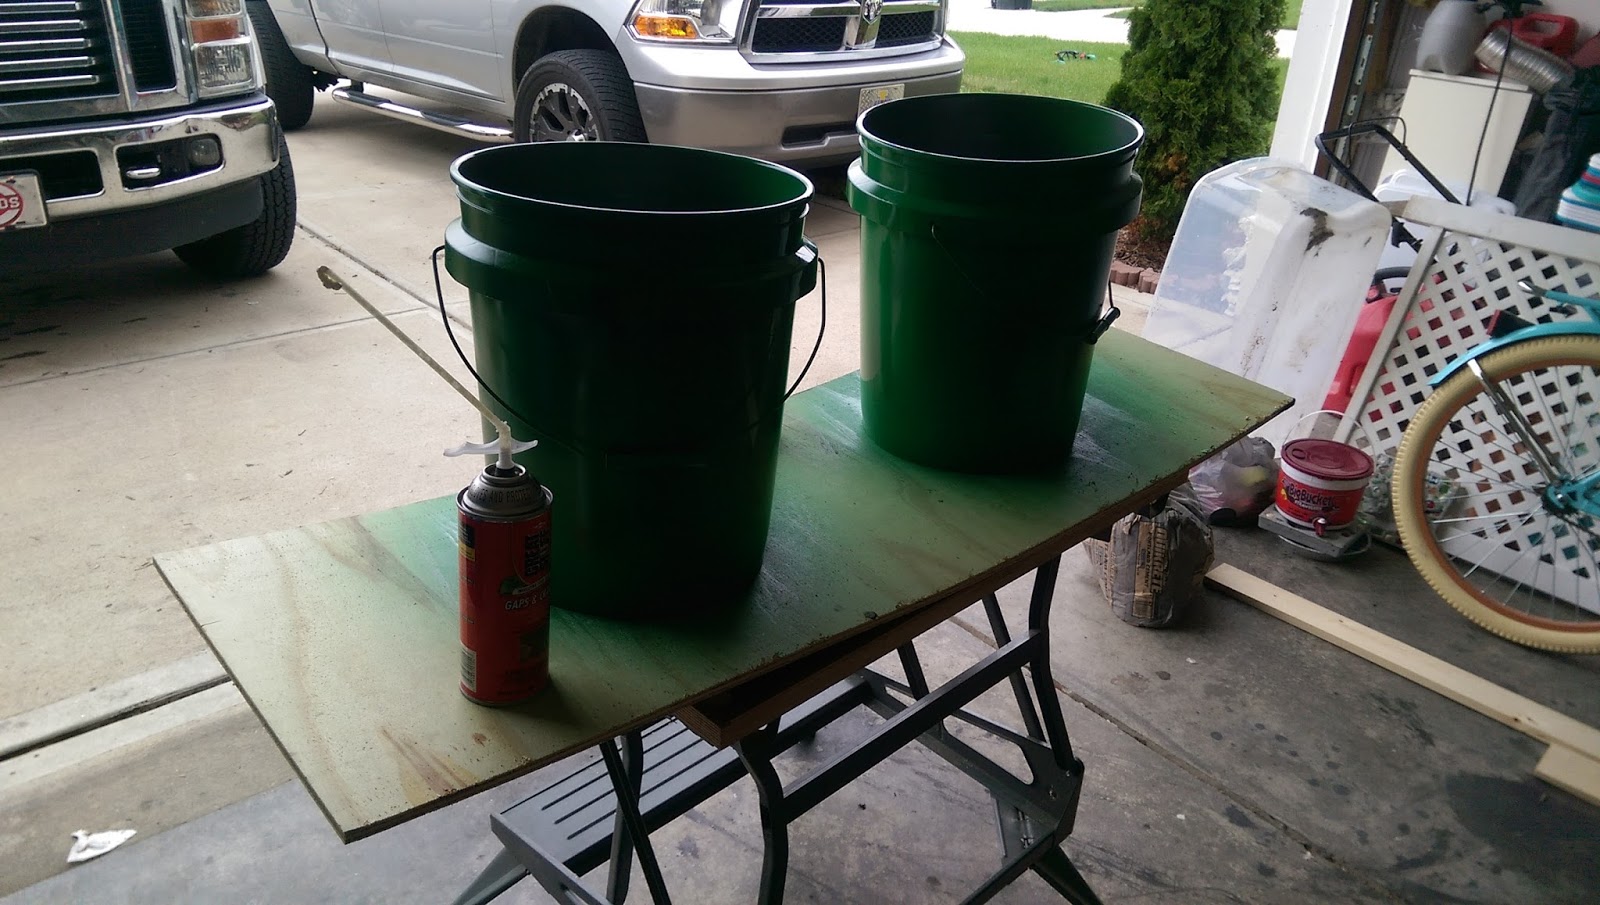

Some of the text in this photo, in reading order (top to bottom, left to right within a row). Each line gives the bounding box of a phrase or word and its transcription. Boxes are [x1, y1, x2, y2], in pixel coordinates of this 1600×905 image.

[489, 490, 503, 503] AND
[1151, 527, 1168, 593] QUIKRETE
[504, 596, 530, 610] GAPS
